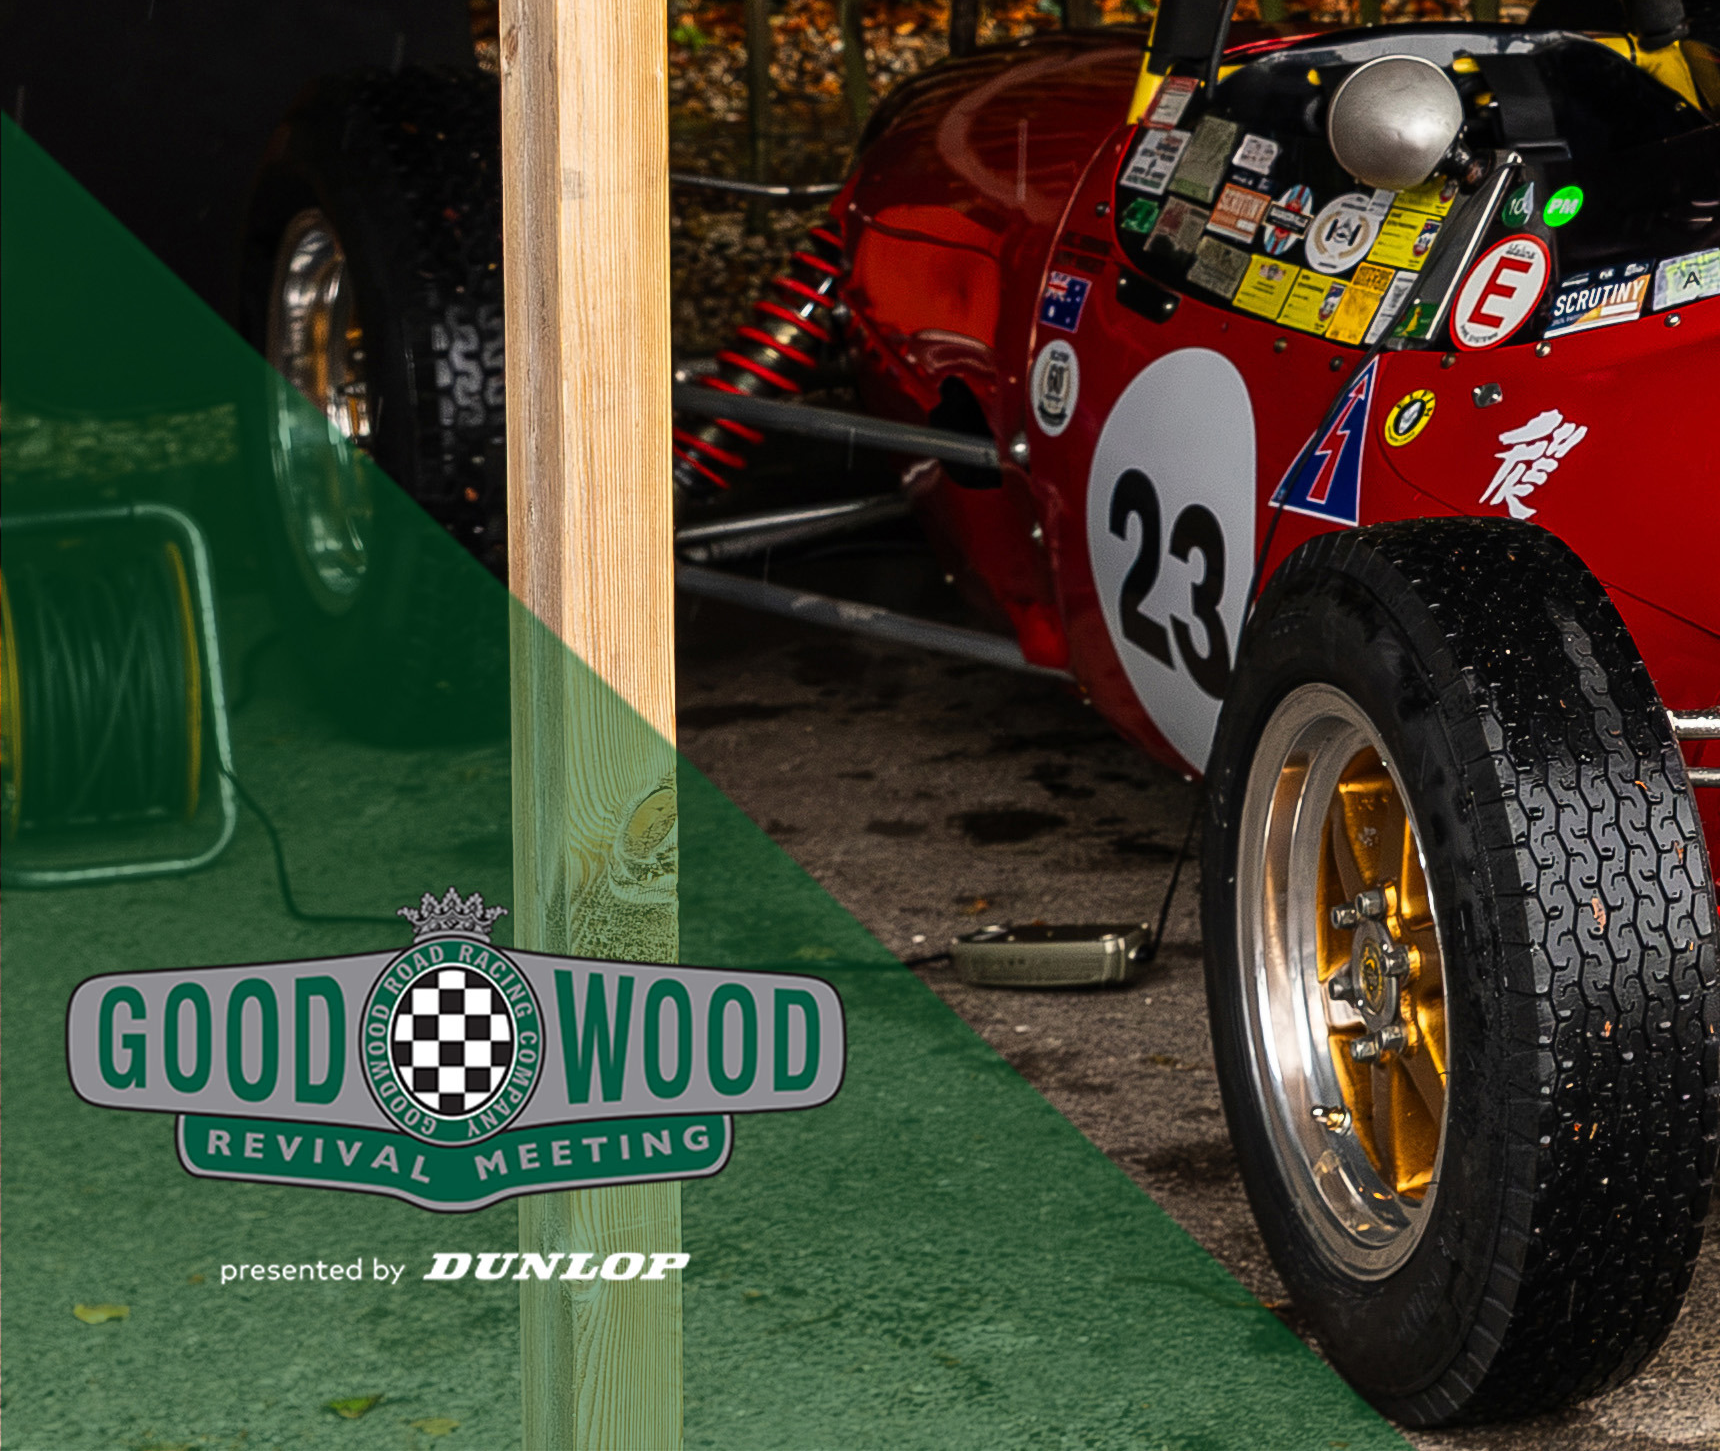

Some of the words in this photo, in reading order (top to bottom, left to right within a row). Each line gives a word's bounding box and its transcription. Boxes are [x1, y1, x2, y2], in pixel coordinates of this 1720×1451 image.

[1546, 198, 1580, 215] PM
[1467, 255, 1533, 329] E
[1554, 279, 1645, 317] SCRUTINY
[1109, 468, 1231, 700] 23
